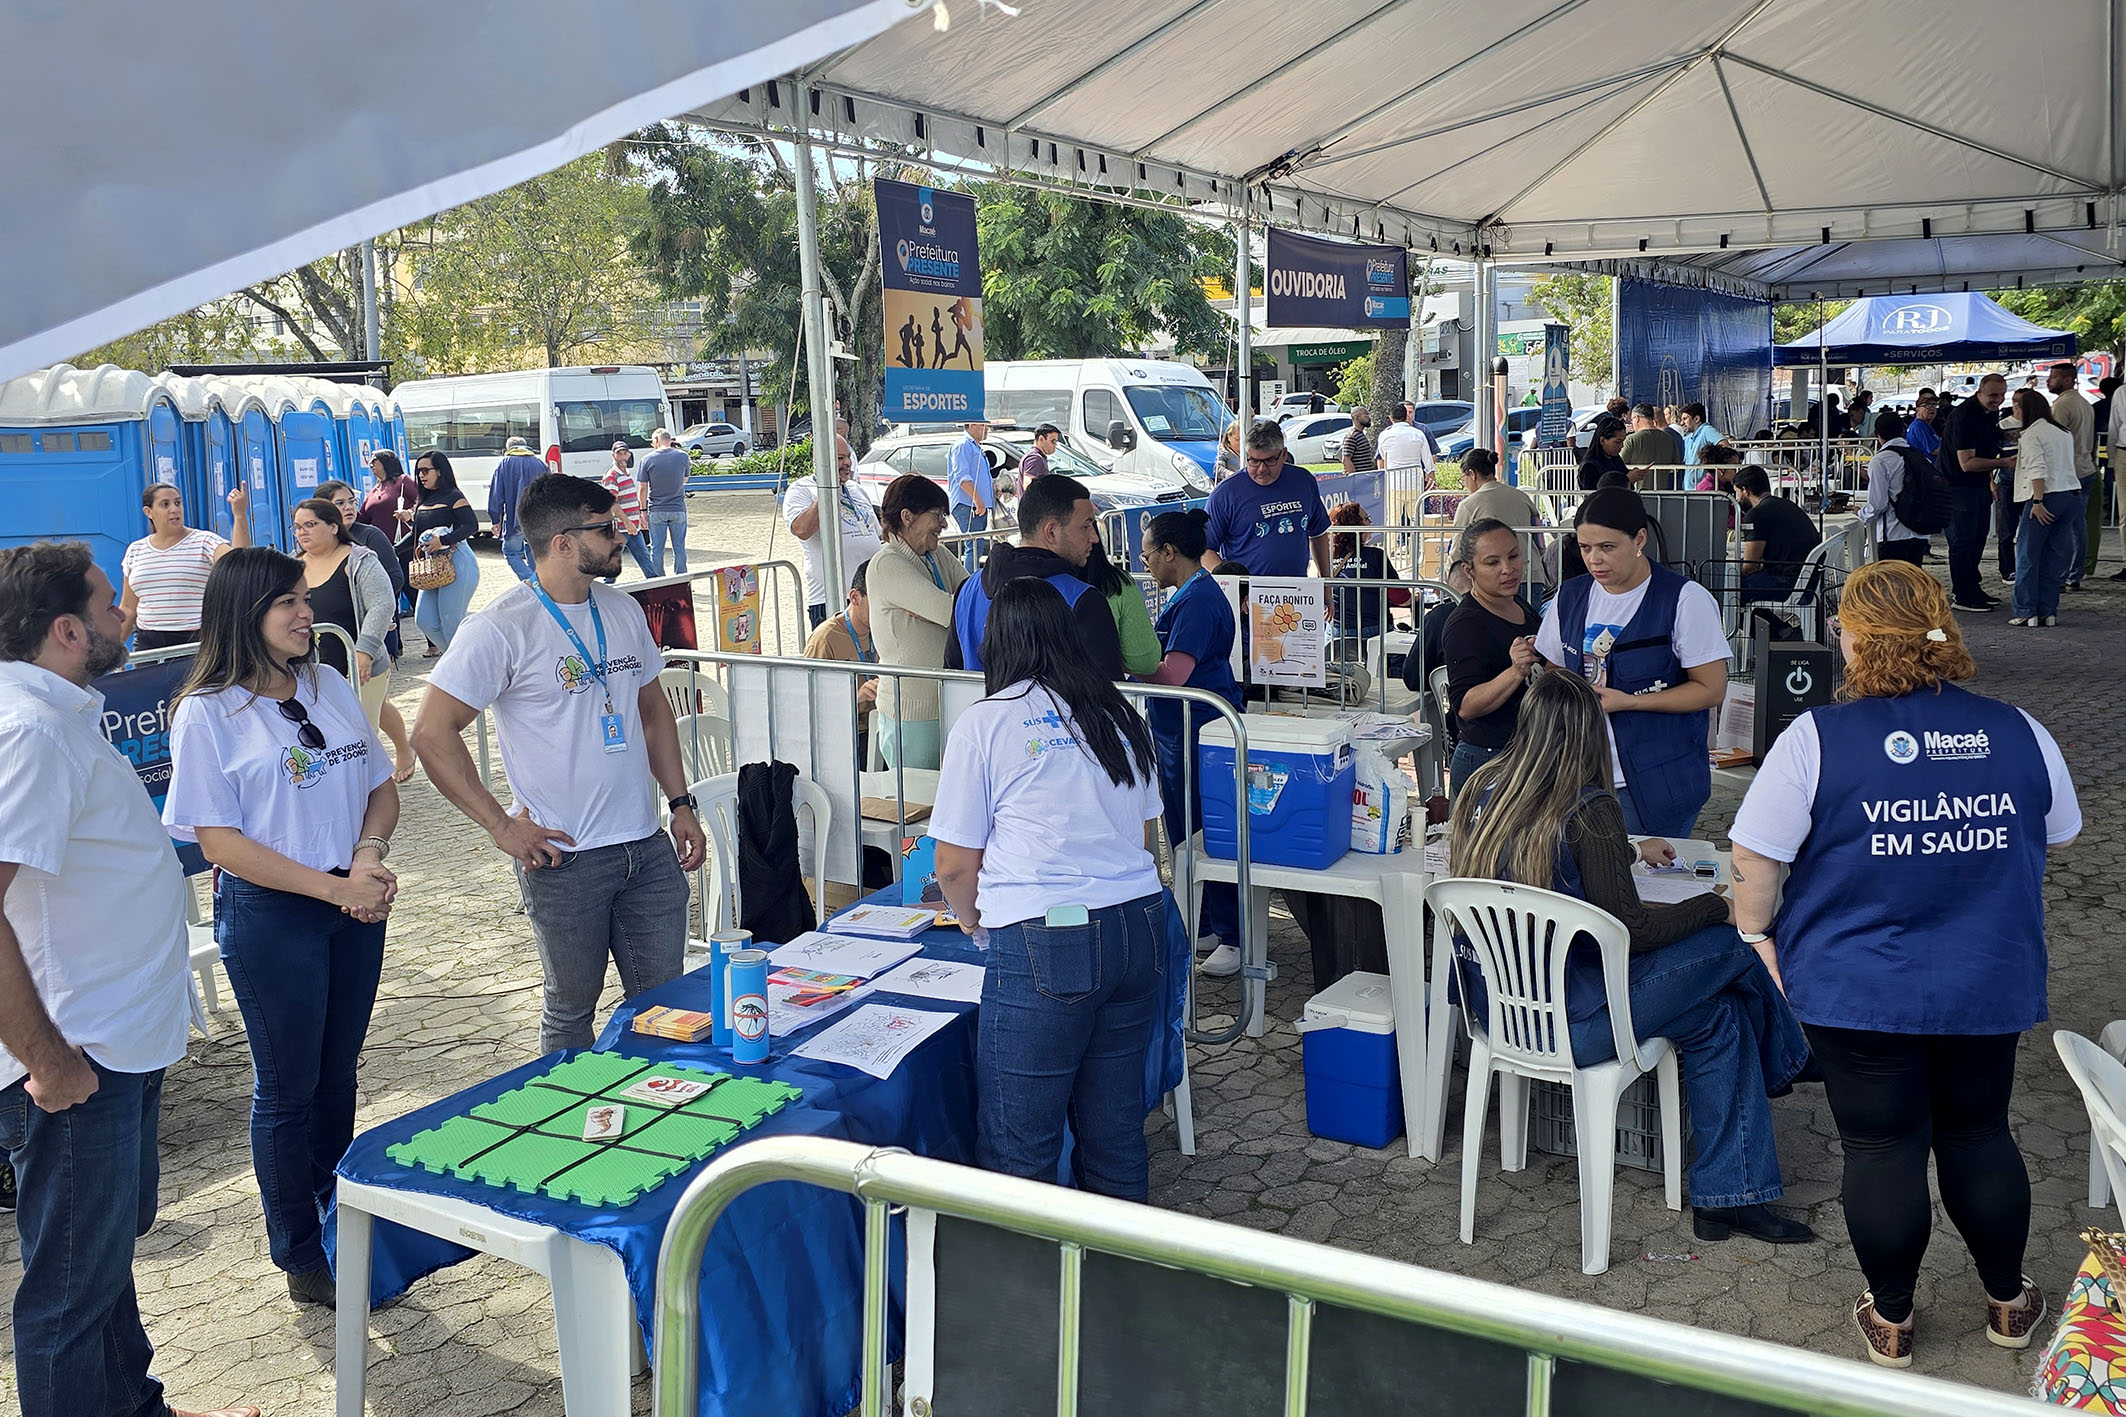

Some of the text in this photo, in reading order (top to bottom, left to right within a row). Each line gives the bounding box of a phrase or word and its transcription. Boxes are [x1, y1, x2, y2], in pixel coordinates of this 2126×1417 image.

[909, 240, 959, 264] Prefeitura
[906, 258, 960, 278] PRESENTE
[1271, 268, 1347, 300] OUVIDORIA
[1896, 309, 1939, 330] RJ
[1296, 346, 1347, 357] TROCA DE ÓLEO
[903, 392, 968, 411] ESPORTES
[1261, 500, 1303, 515] ESPORTES
[1259, 594, 1314, 606] FAÇA BONITO
[1023, 718, 1042, 729] SUS
[1923, 729, 1989, 749] Macaé
[1926, 747, 1991, 755] PREFEITURA
[329, 757, 341, 766] DE
[1862, 792, 2017, 823] VIGILÂNCIA
[1871, 823, 2009, 856] EM SAÚDE
